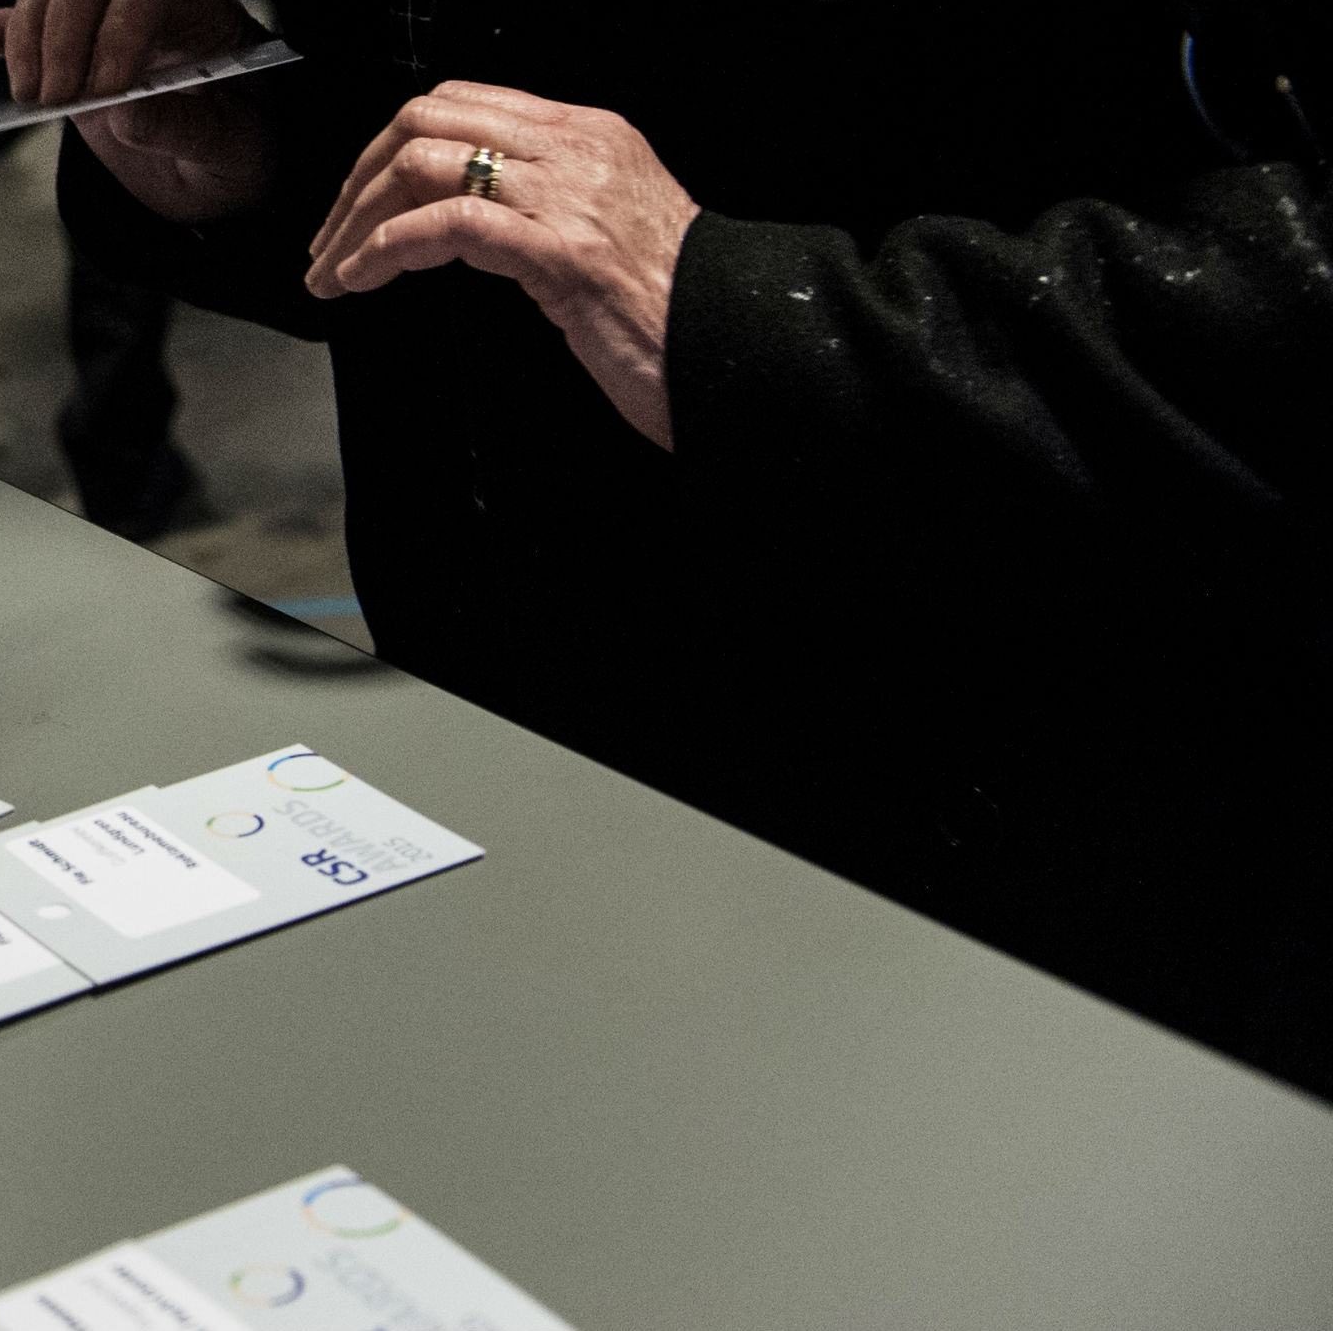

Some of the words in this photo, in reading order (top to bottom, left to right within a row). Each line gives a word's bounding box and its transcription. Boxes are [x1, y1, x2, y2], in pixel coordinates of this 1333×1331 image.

[27, 839, 75, 873] Schmidt
[93, 819, 145, 855] Lundgren
[117, 811, 198, 869] Reklamebureau
[272, 799, 418, 875] AWARDS
[300, 848, 369, 886] CSR
